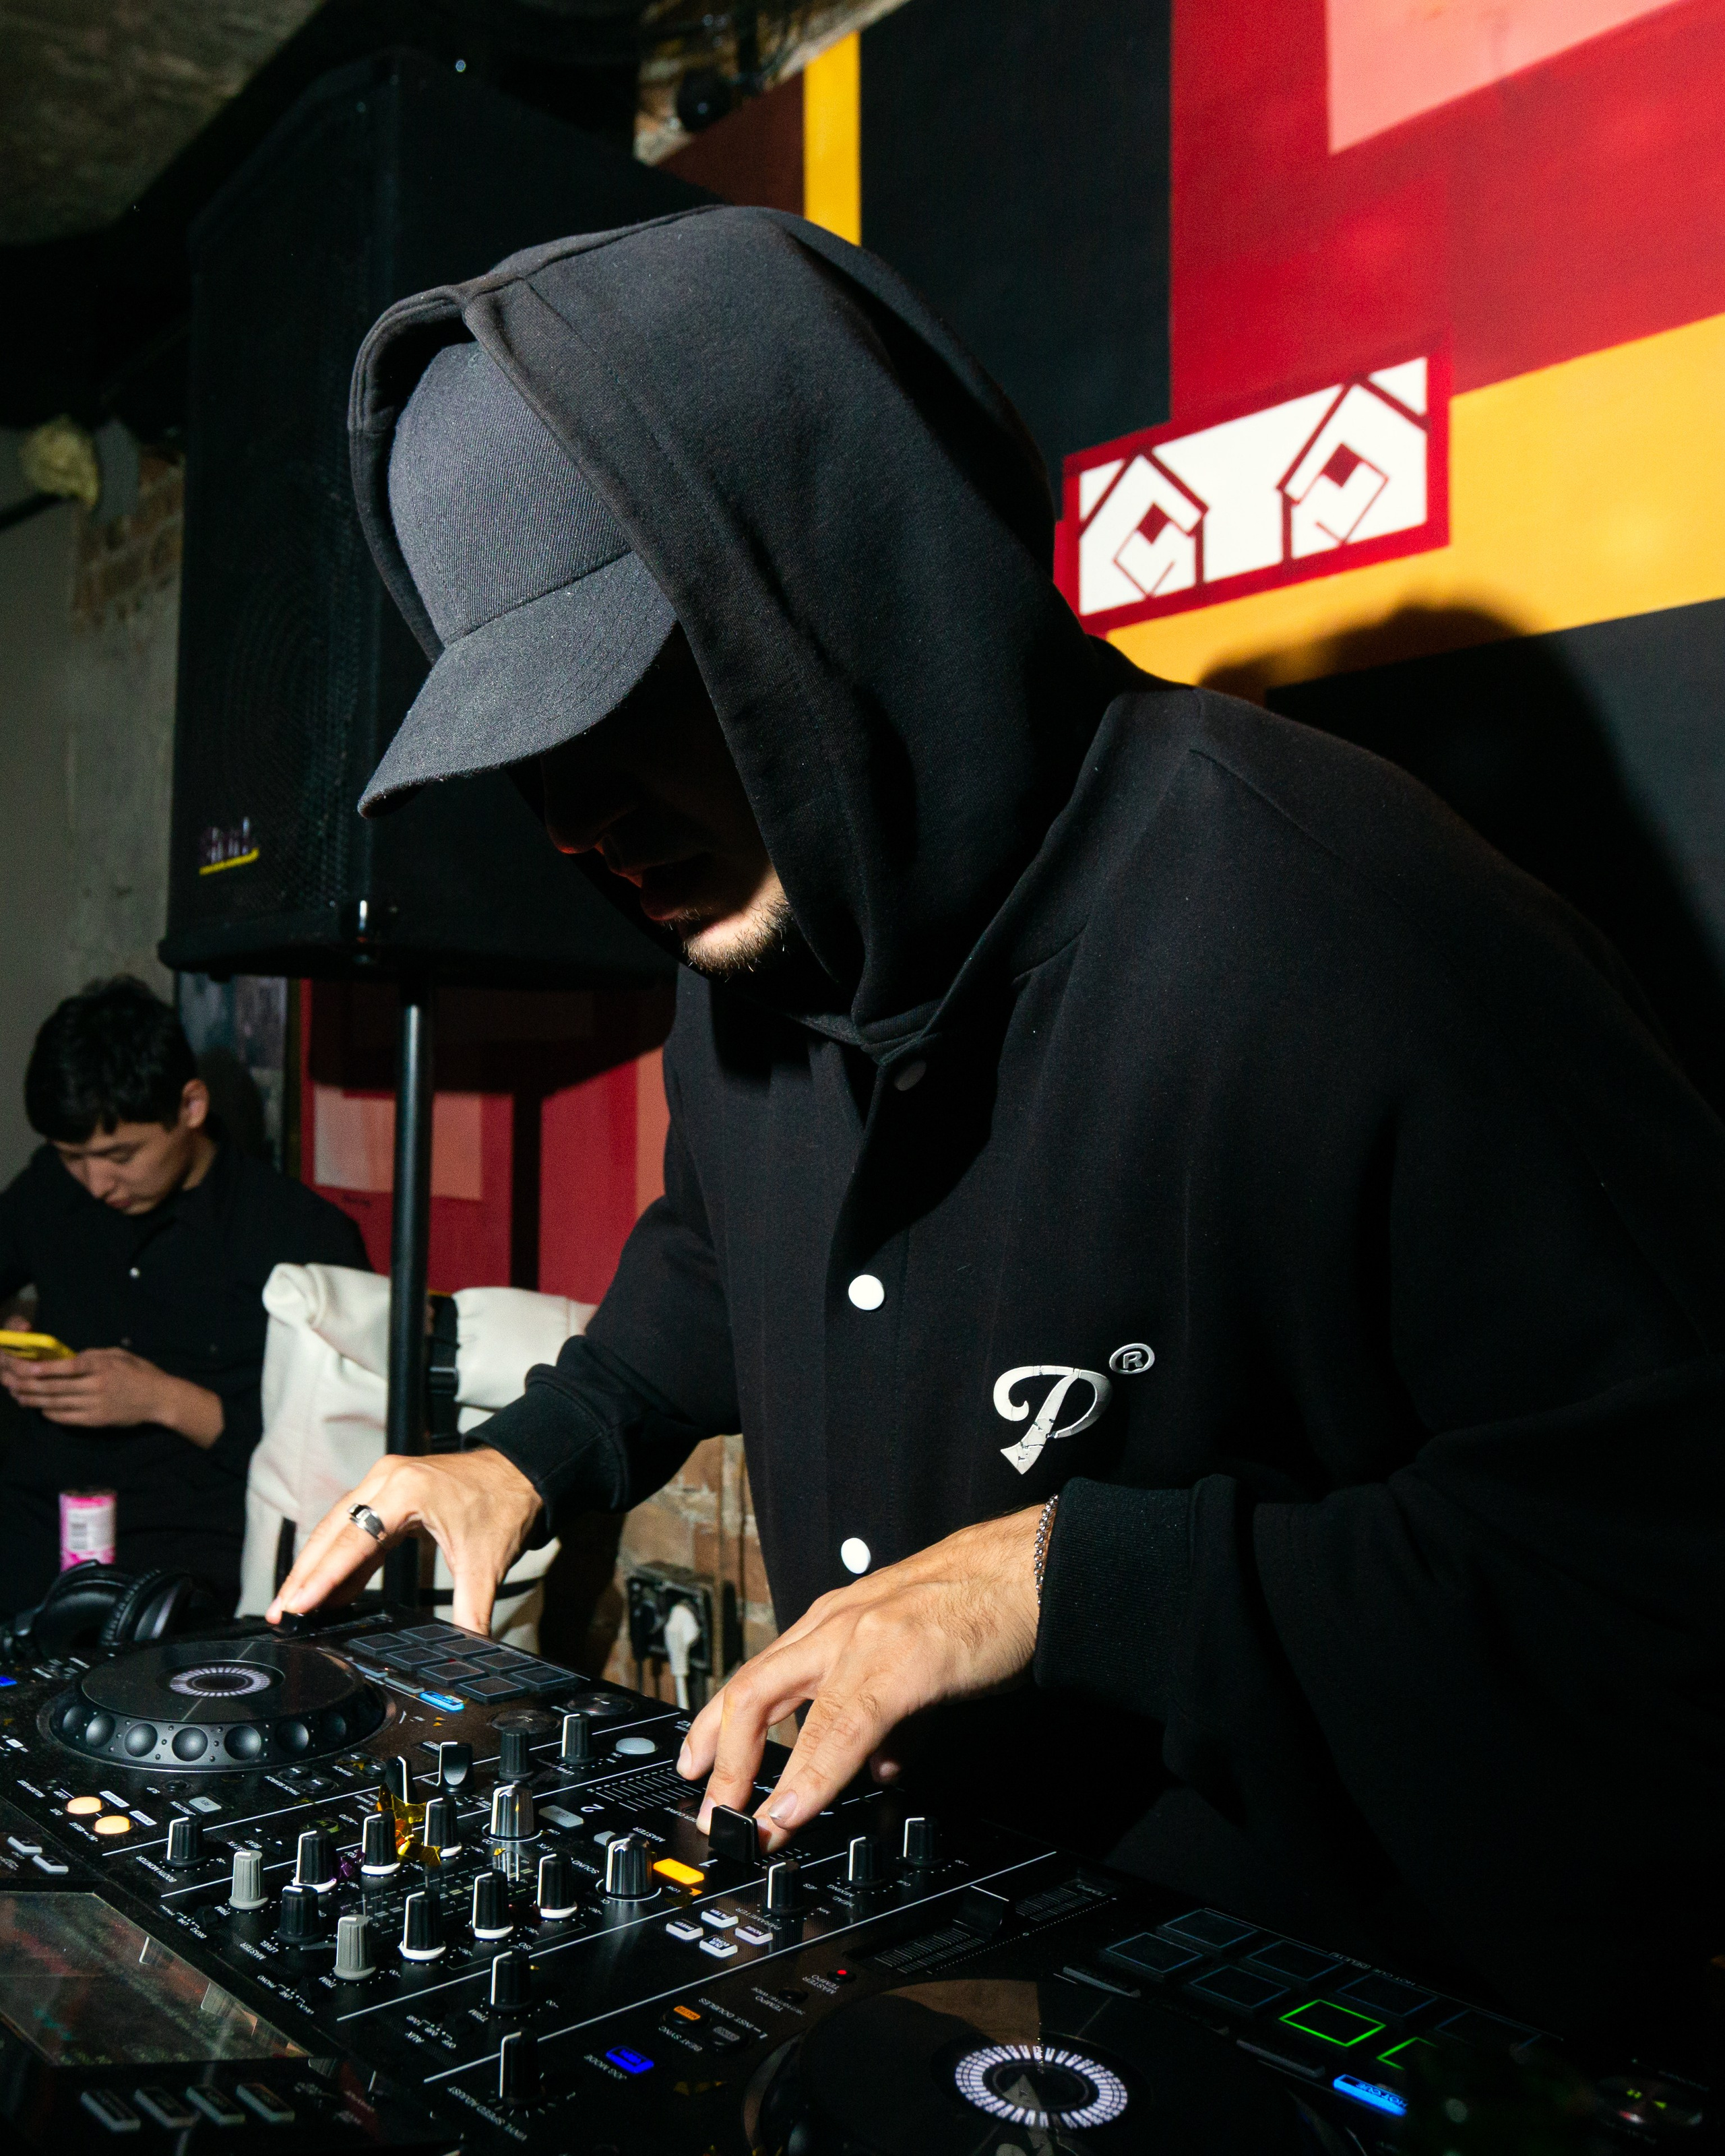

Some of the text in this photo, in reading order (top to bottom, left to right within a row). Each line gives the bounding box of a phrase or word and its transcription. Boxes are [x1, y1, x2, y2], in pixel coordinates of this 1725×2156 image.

[332, 1765, 354, 1777] SEARCH
[264, 1775, 301, 1796] TRACK SEARCH
[53, 1791, 69, 1800] LOOP
[49, 1808, 64, 1816] OUT
[580, 1804, 605, 1813] 2
[663, 1806, 687, 1817] CURVE
[632, 1827, 666, 1843] MASTER
[244, 1839, 263, 1849] BEAT
[135, 1856, 178, 1883] BOOTH MONITOR
[571, 1860, 600, 1874] SOUND
[698, 1859, 718, 1868] 1
[666, 1885, 681, 1893] LOW
[827, 1884, 855, 1898] MIXING
[1077, 1884, 1106, 1897] TEMPO
[214, 1905, 231, 1916] TRIM
[710, 1909, 730, 1920] FILTER
[817, 1907, 831, 1915] MIN
[734, 1907, 782, 1930] PARAMETER
[239, 1942, 267, 1961] MASTER
[259, 1940, 280, 1953] LEVEL
[518, 1942, 534, 1951] ISO
[1373, 1968, 1393, 1977] CUE
[257, 1975, 282, 1989] PHONO
[318, 1976, 337, 1989] TRIM
[802, 1976, 837, 1994] MASTER
[811, 1974, 840, 1990] TEMPO
[1393, 1977, 1416, 1986] HOT
[278, 1990, 294, 2000] LINE
[698, 1998, 735, 2019] DOUBLES
[755, 1995, 784, 2012] TEMPO
[468, 2008, 489, 2023] TRIM
[405, 2031, 425, 2043] AUX
[658, 2026, 703, 2052] BEAT SYNC
[441, 2039, 457, 2049] OFF
[584, 2054, 610, 2071] MODE
[608, 2068, 627, 2080] JOG
[1351, 2082, 1414, 2107] HOT CUE
